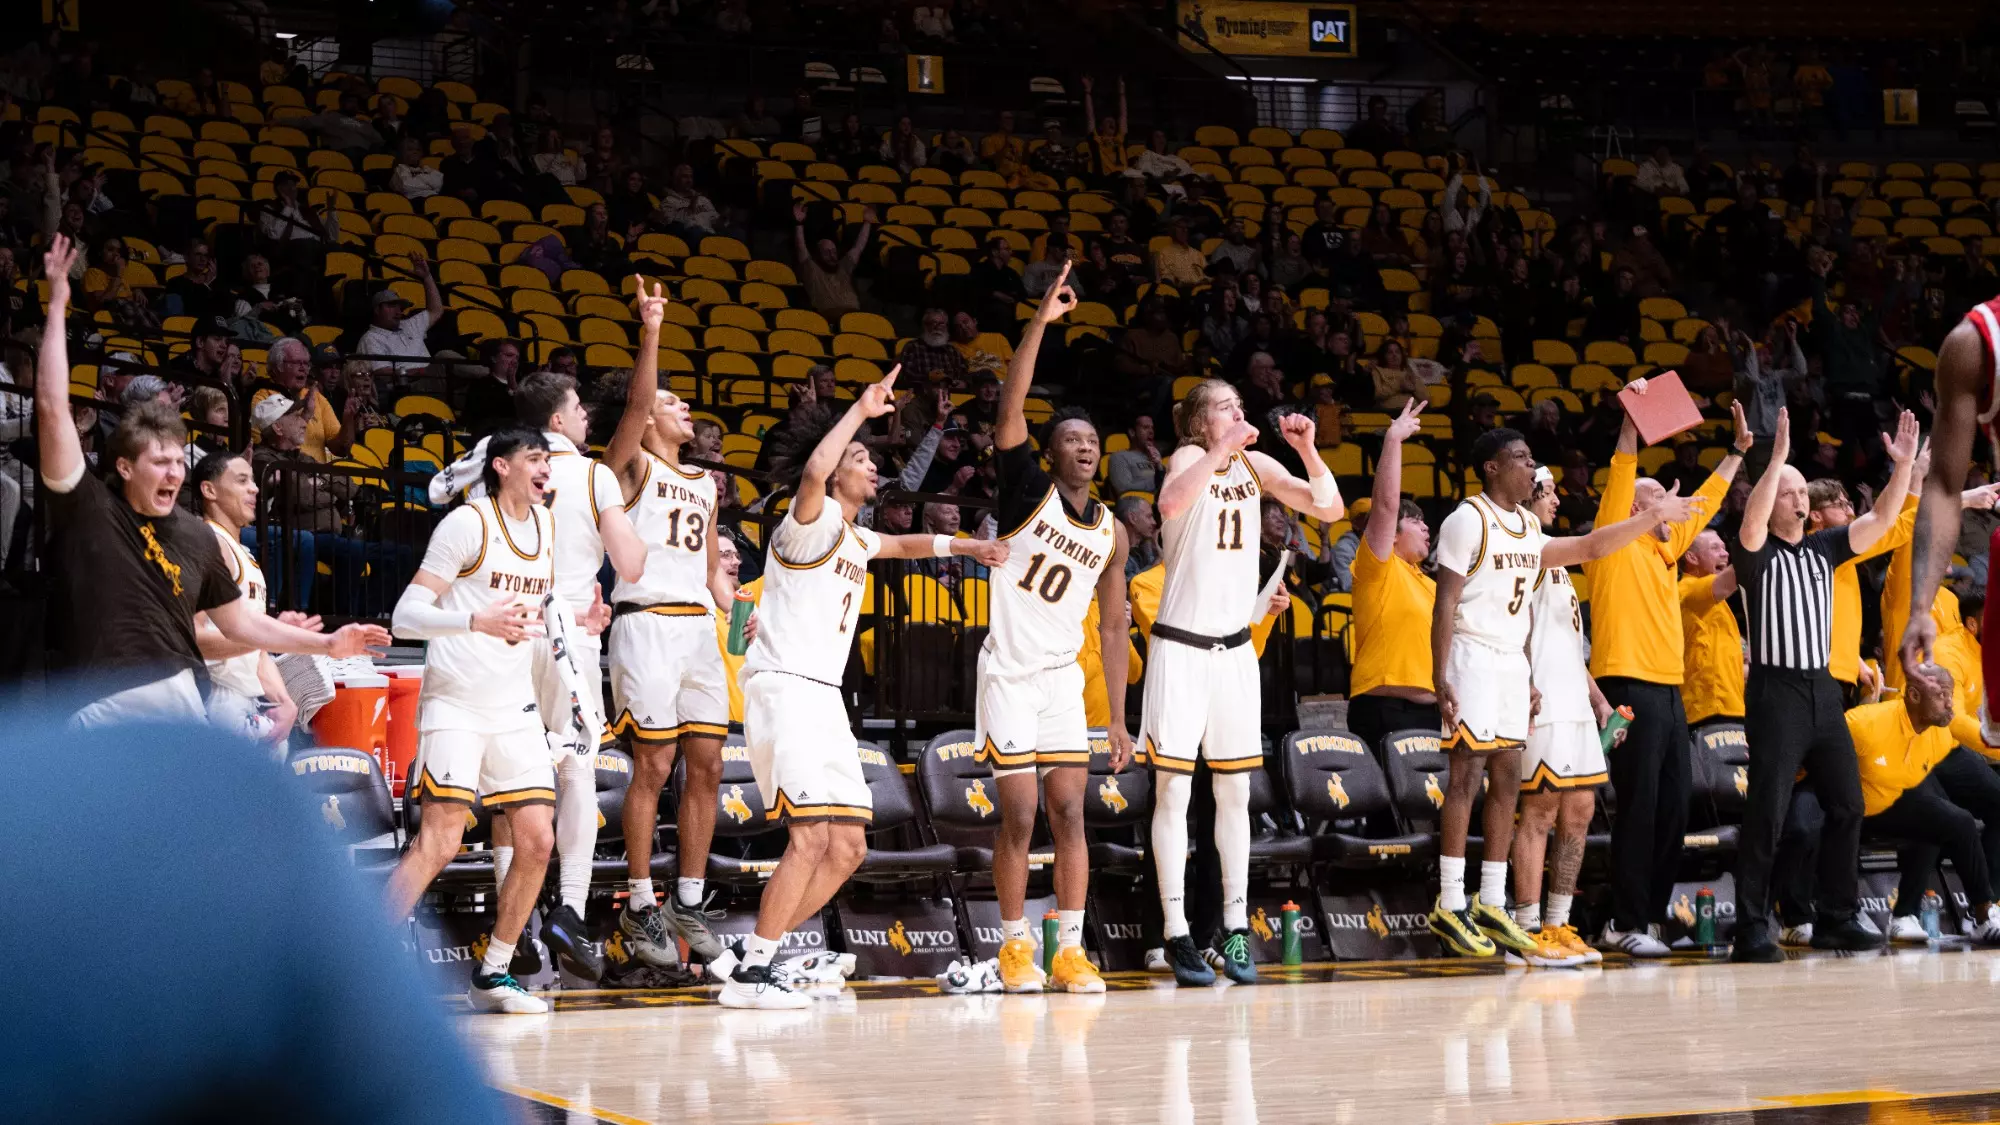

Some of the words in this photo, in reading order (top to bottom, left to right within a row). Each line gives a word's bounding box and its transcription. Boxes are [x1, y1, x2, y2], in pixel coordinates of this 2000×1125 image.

[1216, 16, 1267, 38] Wyoming
[1311, 20, 1347, 43] CAT
[665, 507, 705, 553] 13
[1216, 508, 1243, 550] 11
[1033, 519, 1102, 570] WYOMING
[1017, 552, 1072, 604] 10
[1507, 576, 1526, 615] 5
[839, 591, 852, 634] 2
[1570, 594, 1580, 632] 3
[1296, 735, 1365, 755] WYOMING
[292, 755, 371, 776] WYOMING
[1103, 923, 1143, 940] UNI
[1328, 912, 1367, 929] UNI
[1383, 912, 1429, 929] WYO
[846, 928, 889, 946] UNI
[906, 930, 954, 946] WYO
[425, 945, 472, 964] UNI
[780, 947, 802, 955] CREDIT
